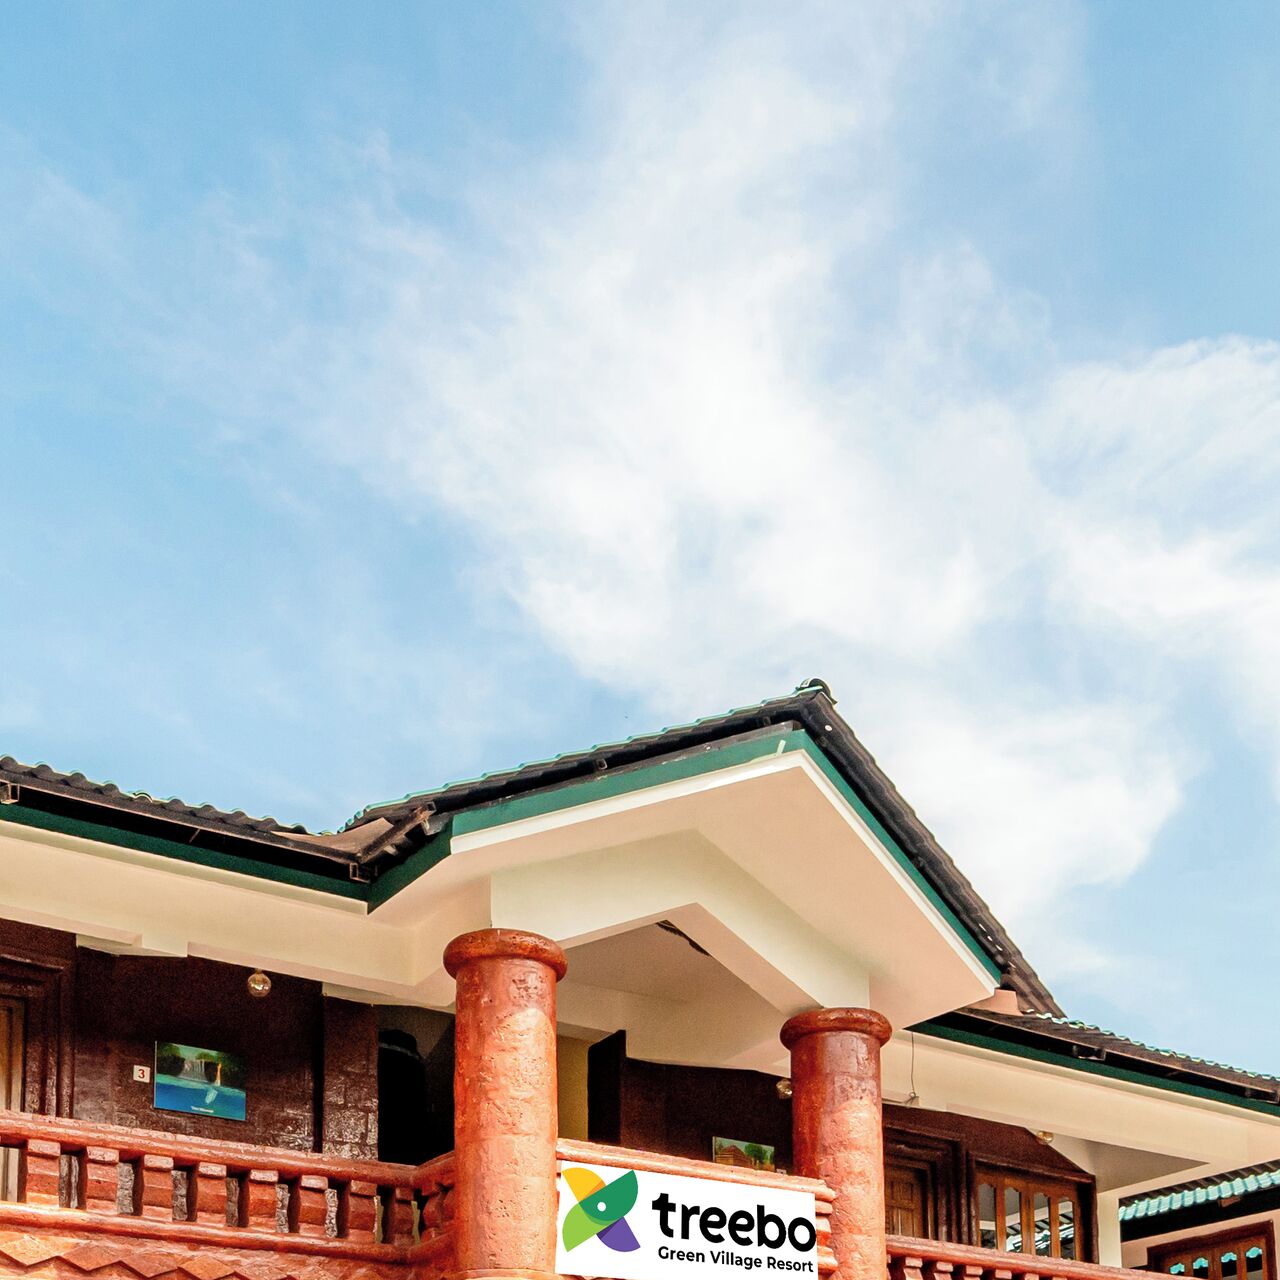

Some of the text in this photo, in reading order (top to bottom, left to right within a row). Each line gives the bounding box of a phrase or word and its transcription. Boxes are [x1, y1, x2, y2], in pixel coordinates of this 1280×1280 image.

[137, 1068, 146, 1079] 3
[651, 1193, 816, 1253] treebo
[658, 1245, 814, 1273] Green Village Resort
